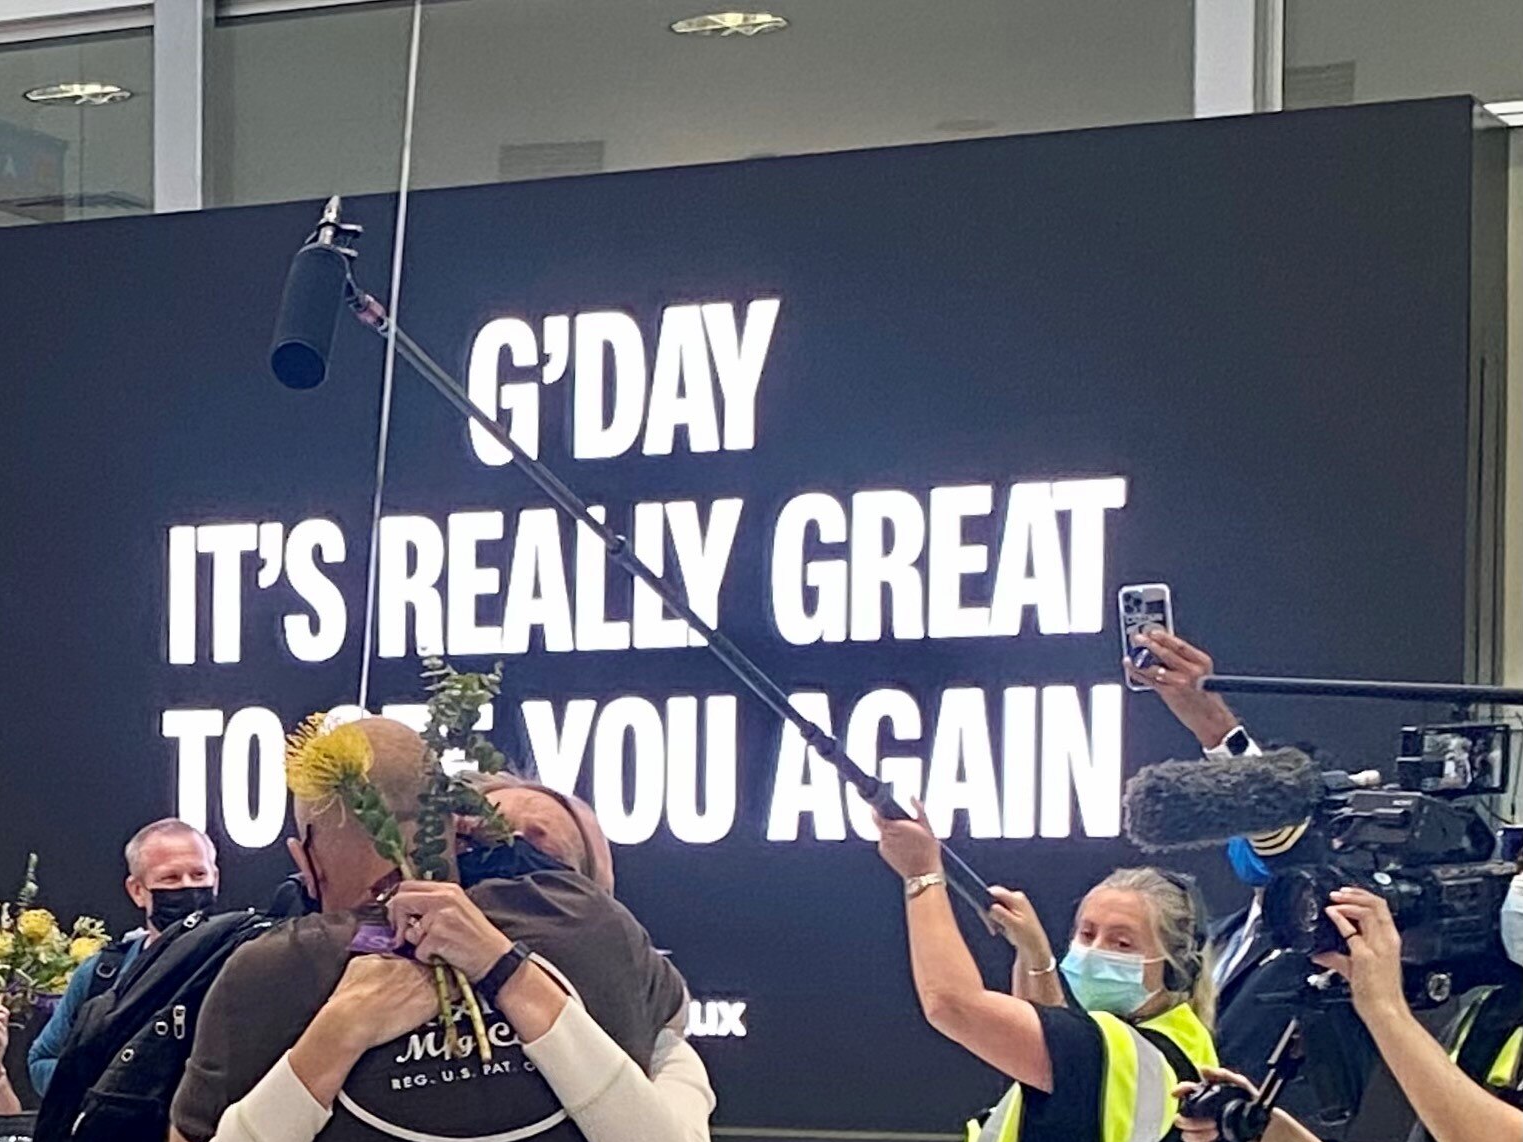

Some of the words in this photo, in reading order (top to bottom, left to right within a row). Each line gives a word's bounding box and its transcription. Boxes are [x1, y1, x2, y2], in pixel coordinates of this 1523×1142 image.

[378, 498, 743, 657] REALLY
[771, 477, 1127, 645] GREAT
[162, 707, 288, 849] TO
[522, 695, 736, 844] YOU
[766, 683, 1123, 841] AGAIN
[390, 1074, 437, 1091] REG.
